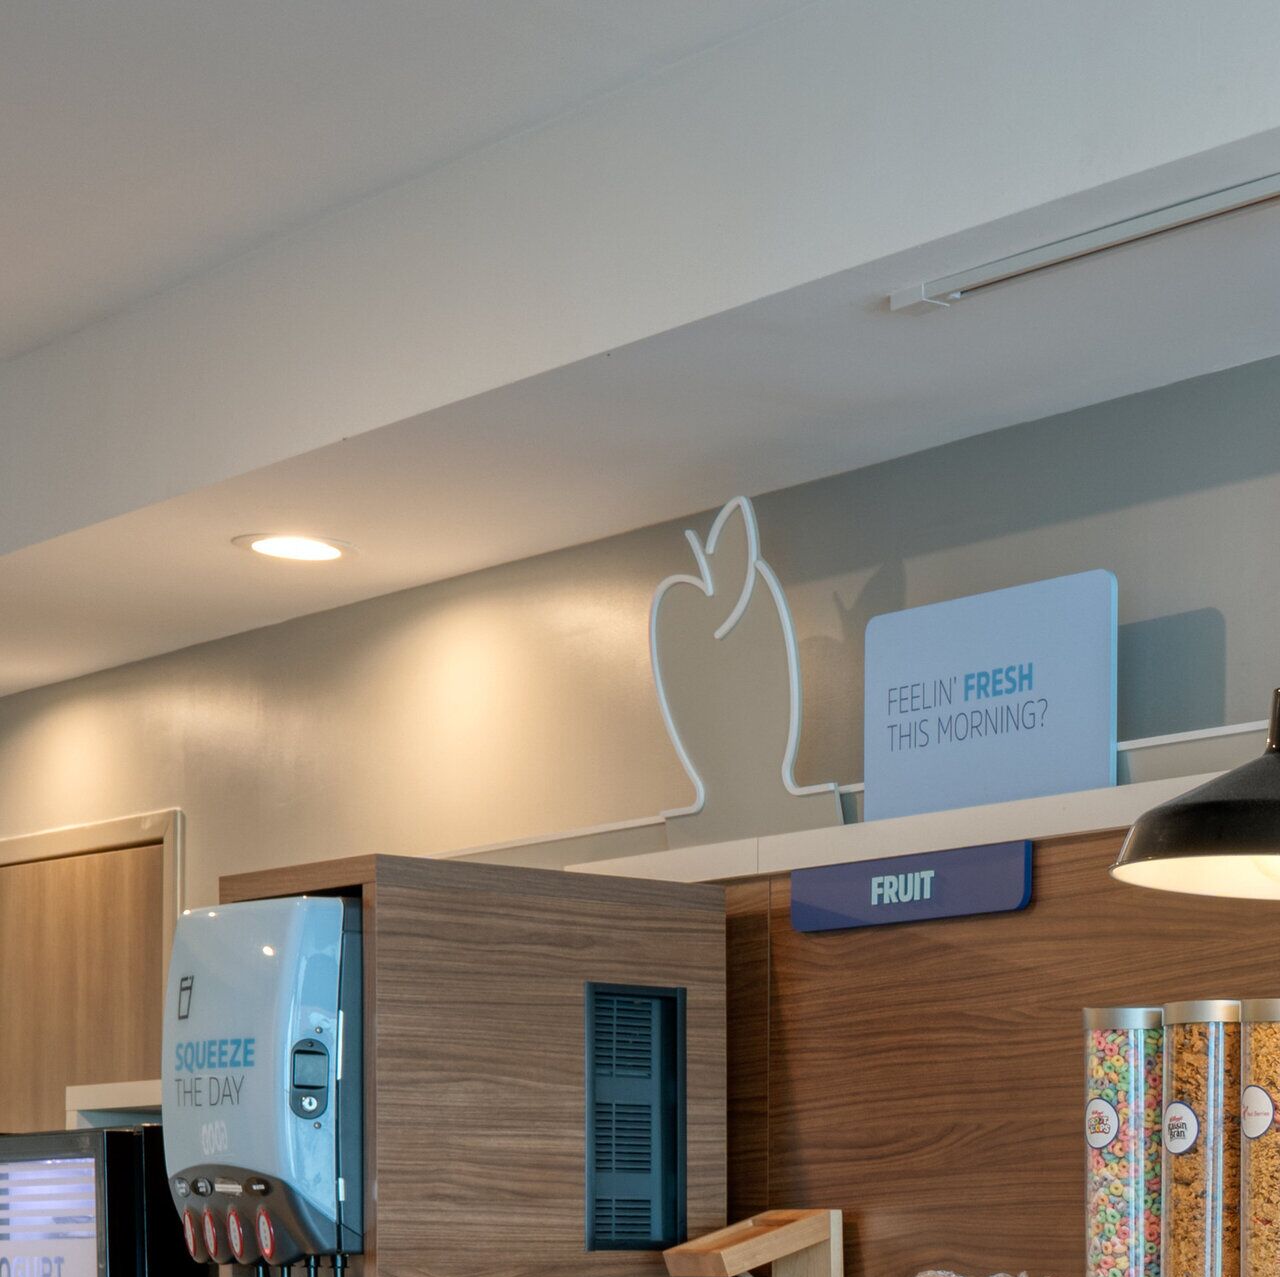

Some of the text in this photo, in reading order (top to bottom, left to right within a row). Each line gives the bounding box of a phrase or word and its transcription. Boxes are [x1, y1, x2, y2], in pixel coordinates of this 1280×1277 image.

[887, 662, 1034, 716] FEELIN' FRESH
[887, 698, 1048, 752] THIS MORNING?
[871, 870, 935, 905] FRUIT
[175, 1038, 256, 1073] SQUEEZE
[174, 1075, 245, 1107] THE DAY
